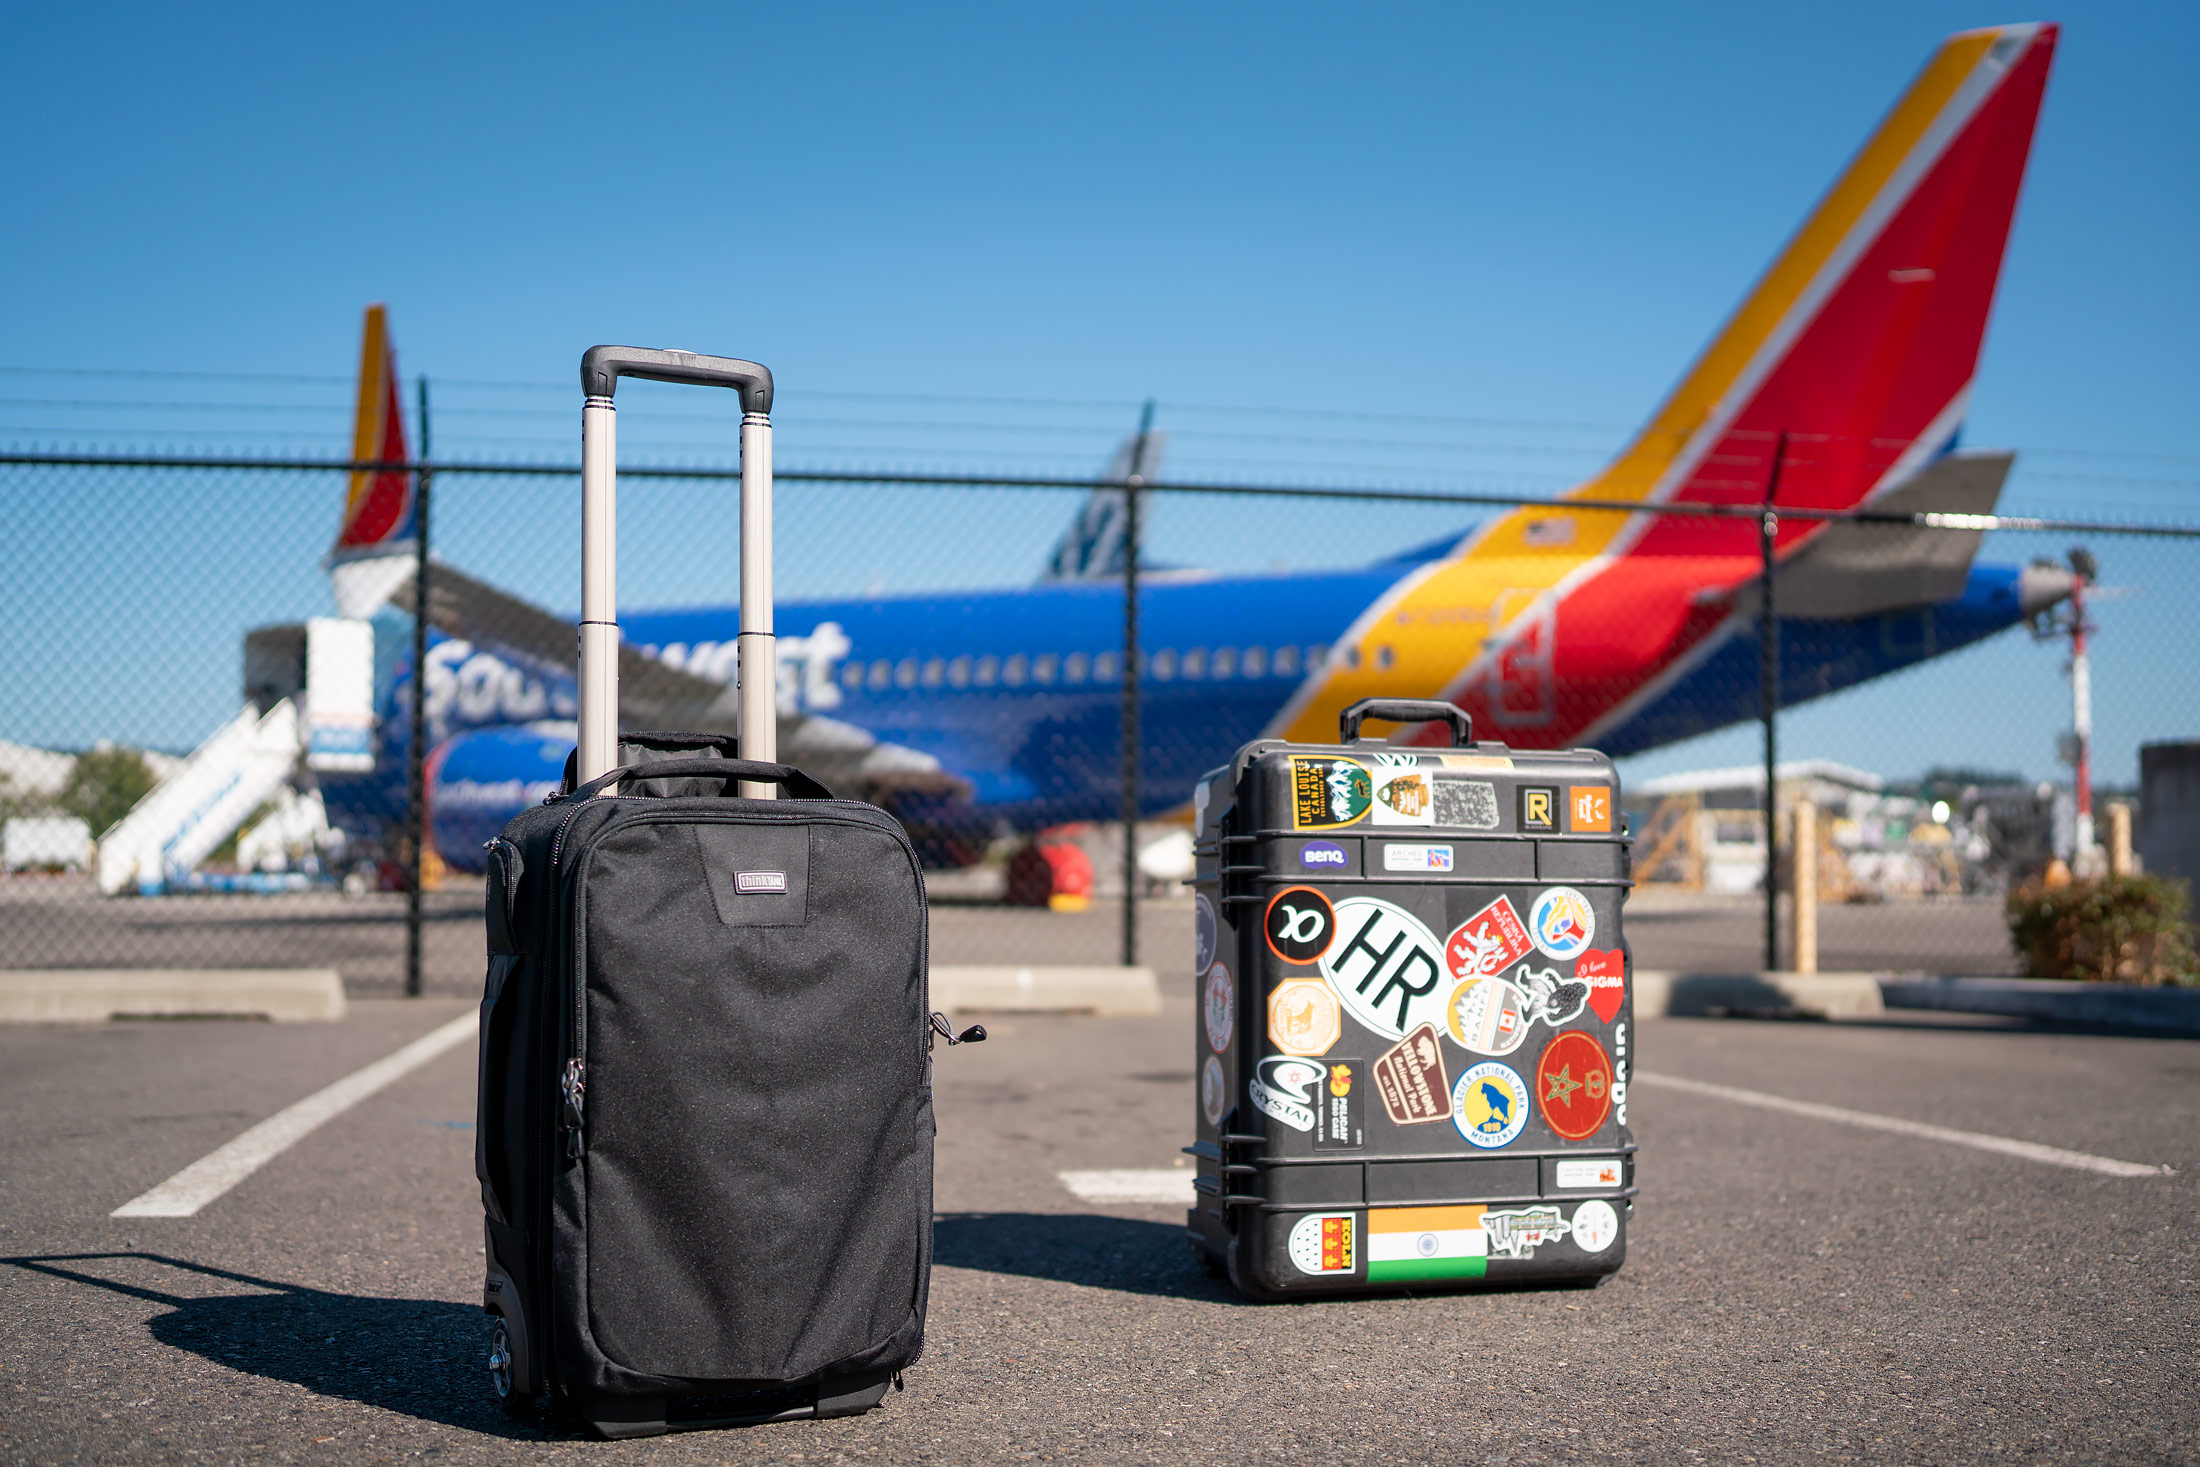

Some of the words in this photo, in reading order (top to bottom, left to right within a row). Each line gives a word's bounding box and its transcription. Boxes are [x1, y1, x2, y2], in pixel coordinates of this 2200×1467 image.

[1296, 760, 1311, 796] LOUISE
[1309, 767, 1320, 815] CANADA
[1299, 800, 1312, 824] LAKE
[1529, 793, 1553, 826] R
[1490, 905, 1523, 957] REPUBLIKA
[1331, 908, 1440, 1033] HR
[1589, 961, 1607, 973] love
[1393, 1056, 1415, 1095] National
[1406, 1089, 1423, 1114] Park
[1400, 1040, 1438, 1117] YELLOWSTONE
[1456, 1075, 1472, 1114] GLACIER
[1474, 1065, 1514, 1083] NATIONAL
[1515, 1084, 1526, 1110] PARK
[1251, 1084, 1310, 1123] CRYSTAL
[1331, 1117, 1340, 1139] CASE
[1470, 1128, 1514, 1144] MONTANA
